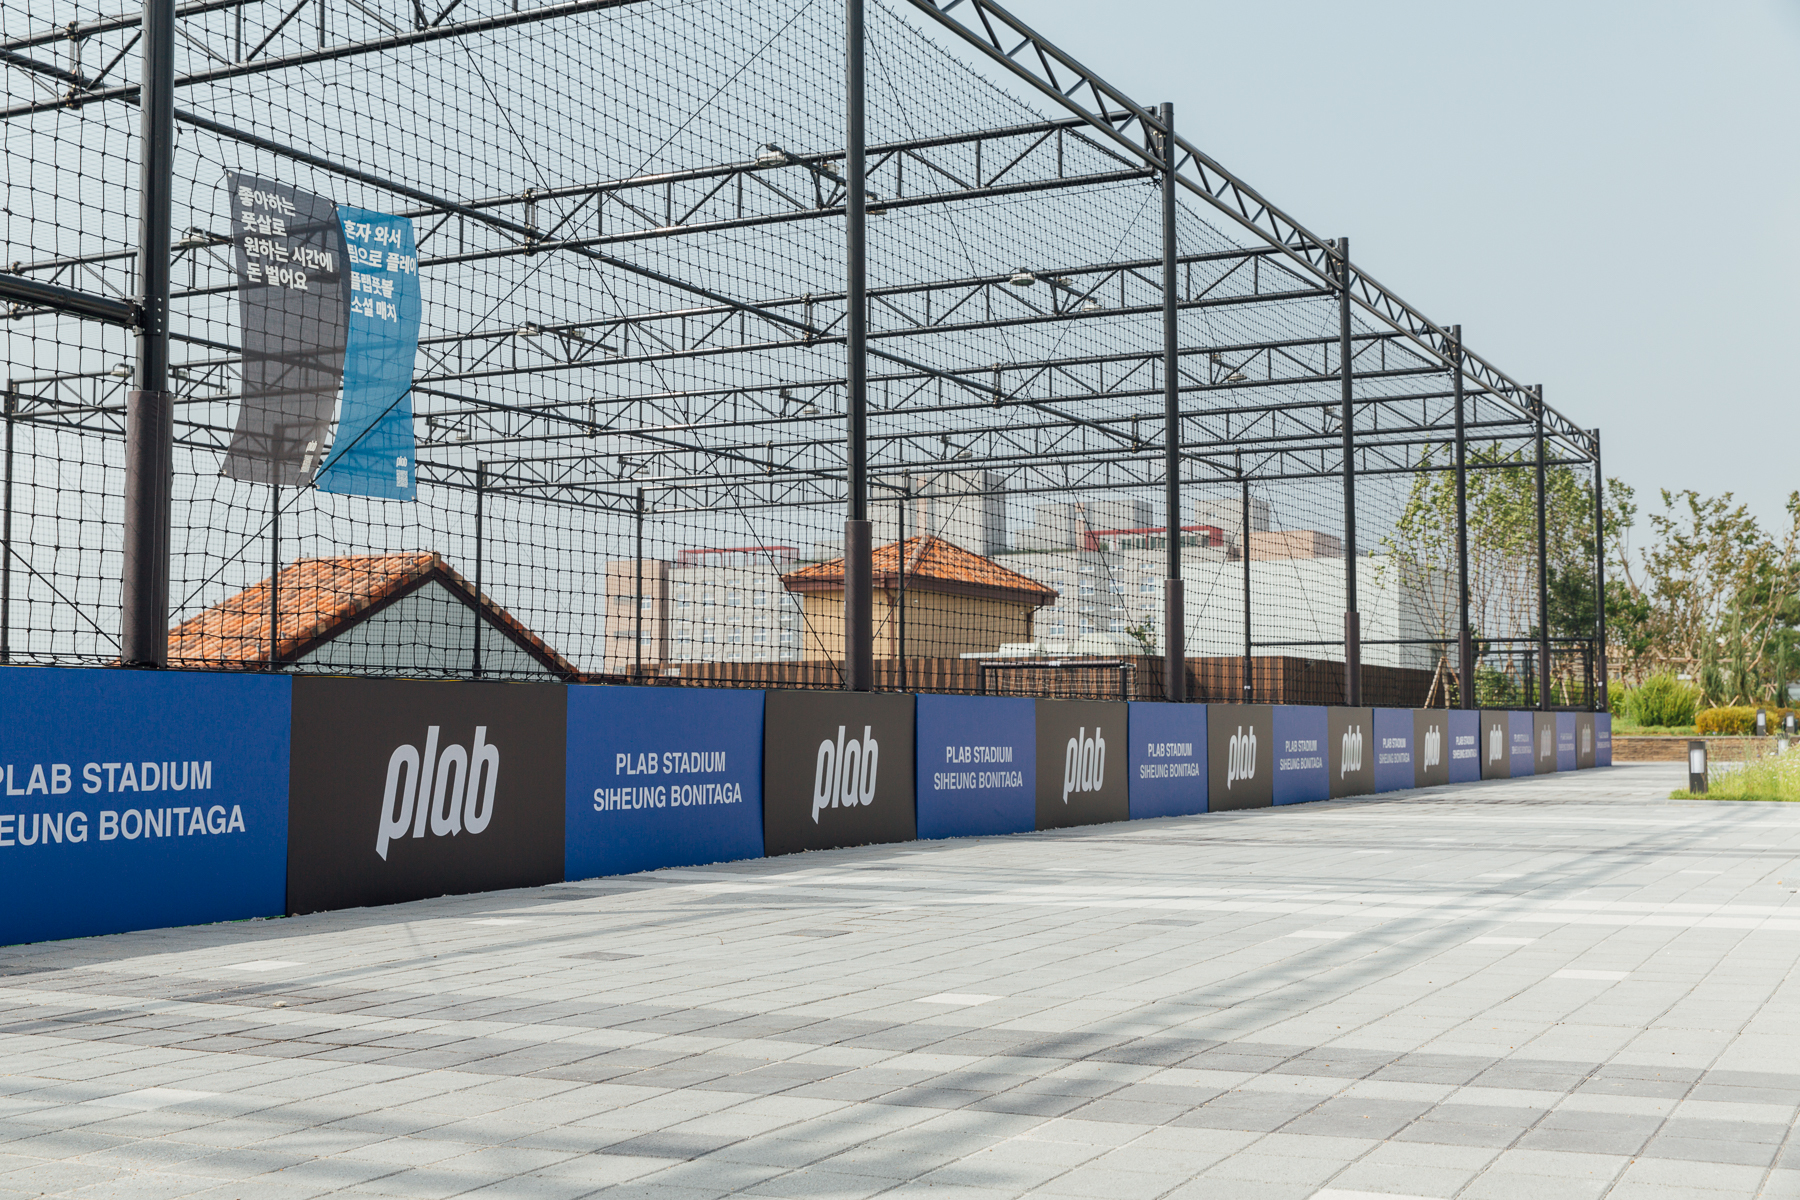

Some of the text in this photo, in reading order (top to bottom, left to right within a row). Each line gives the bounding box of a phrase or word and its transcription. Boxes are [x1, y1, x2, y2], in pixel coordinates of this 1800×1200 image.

[238, 185, 296, 217] 좋아하는
[241, 211, 287, 237] 풋살로
[344, 219, 401, 249] 혼자 와서
[244, 236, 333, 272] 원하는 시간에
[347, 243, 417, 277] 팀으로 플레이
[246, 261, 308, 290] 돈 벌어요
[350, 270, 394, 299] 플랩풋볼
[351, 295, 397, 323] 소셜 매치
[616, 752, 725, 775] PLAB STADIUM
[946, 746, 1012, 763] PLAB STADIUM
[1148, 743, 1192, 757] PLAB STADIUM
[1227, 726, 1257, 790] plab
[1340, 725, 1363, 780] plab
[1424, 725, 1441, 773] plab
[82, 761, 212, 794] STADIUM
[812, 726, 878, 824] plab
[934, 771, 1023, 790] SIHEUNG BONITAGA
[1063, 726, 1106, 804] plab
[1140, 763, 1200, 779] SIHEUNG BONITAGA
[376, 726, 499, 861] plab
[594, 783, 742, 811] SIHEUNG BONITAGA
[99, 804, 246, 841] BONITAGA
